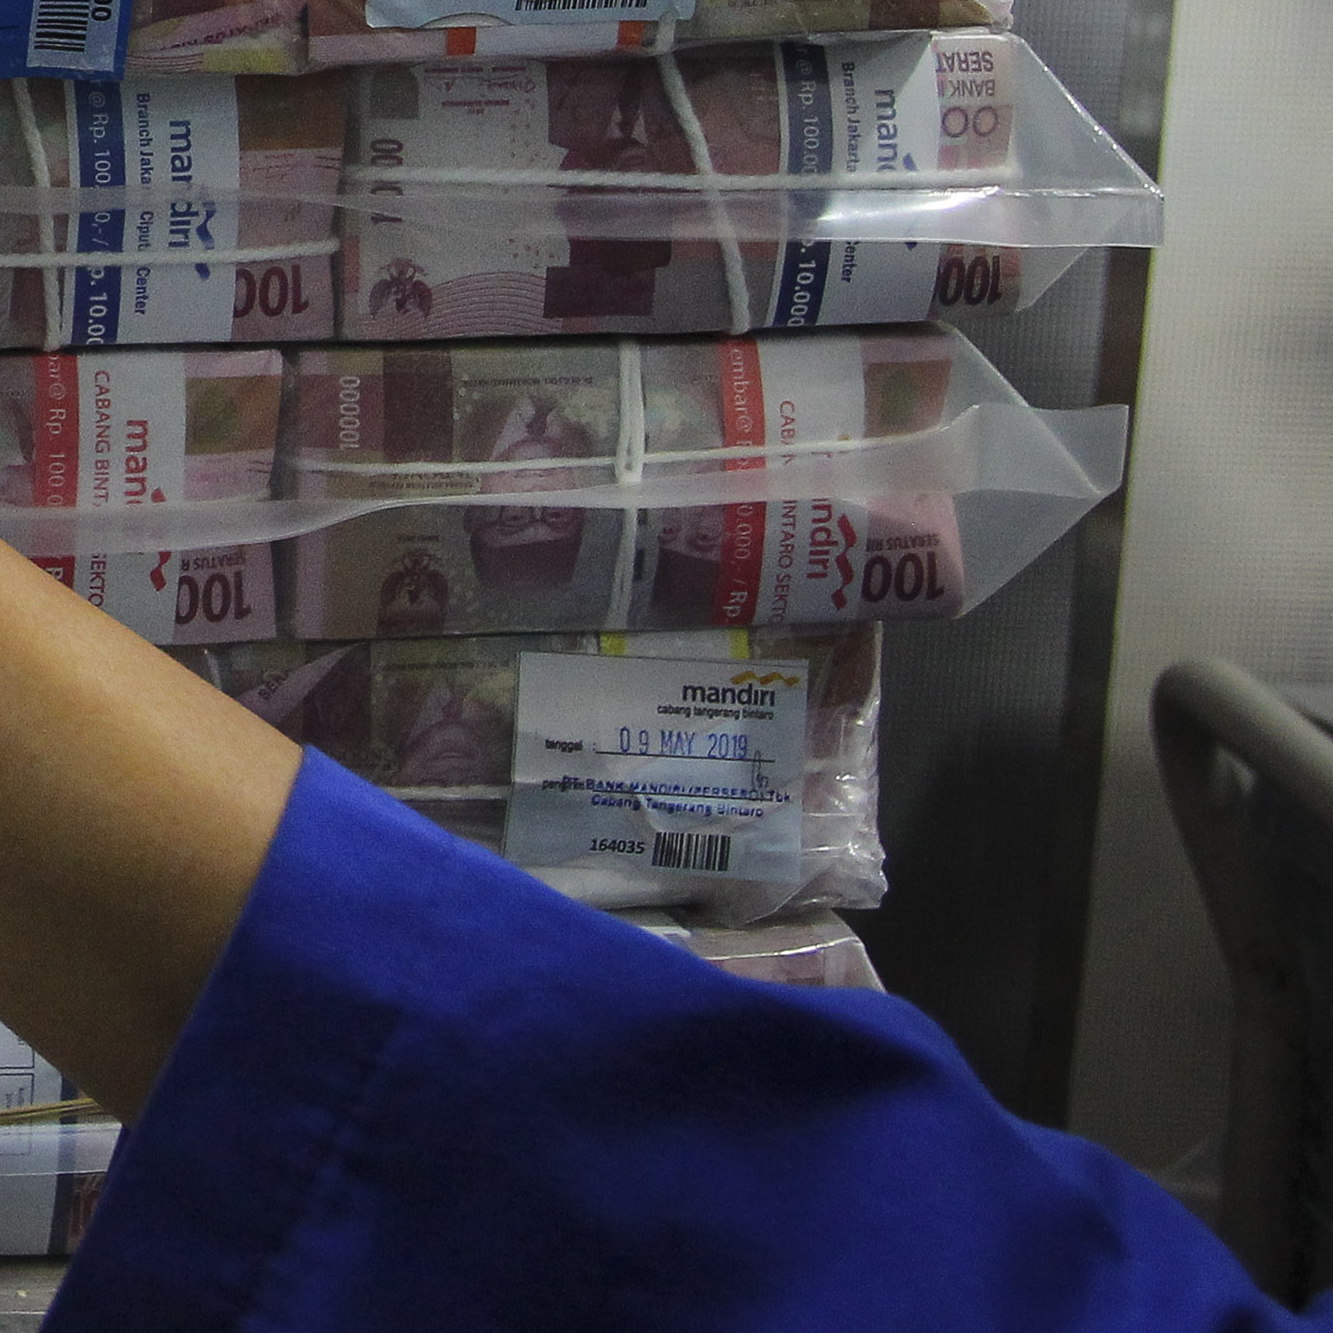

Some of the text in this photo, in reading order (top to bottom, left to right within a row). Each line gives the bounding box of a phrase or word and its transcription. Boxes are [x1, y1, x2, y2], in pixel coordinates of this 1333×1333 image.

[798, 80, 819, 109] Rp.
[841, 61, 859, 115] Branch
[90, 113, 109, 145] Rp.
[135, 92, 154, 148] Branch
[91, 370, 111, 454] CABANG
[682, 684, 777, 708] mandiri
[657, 704, 775, 720] cabang tangerang bintaro
[545, 739, 583, 752] tanggal
[660, 730, 749, 759] MAY 2019
[588, 838, 646, 855] 164035
